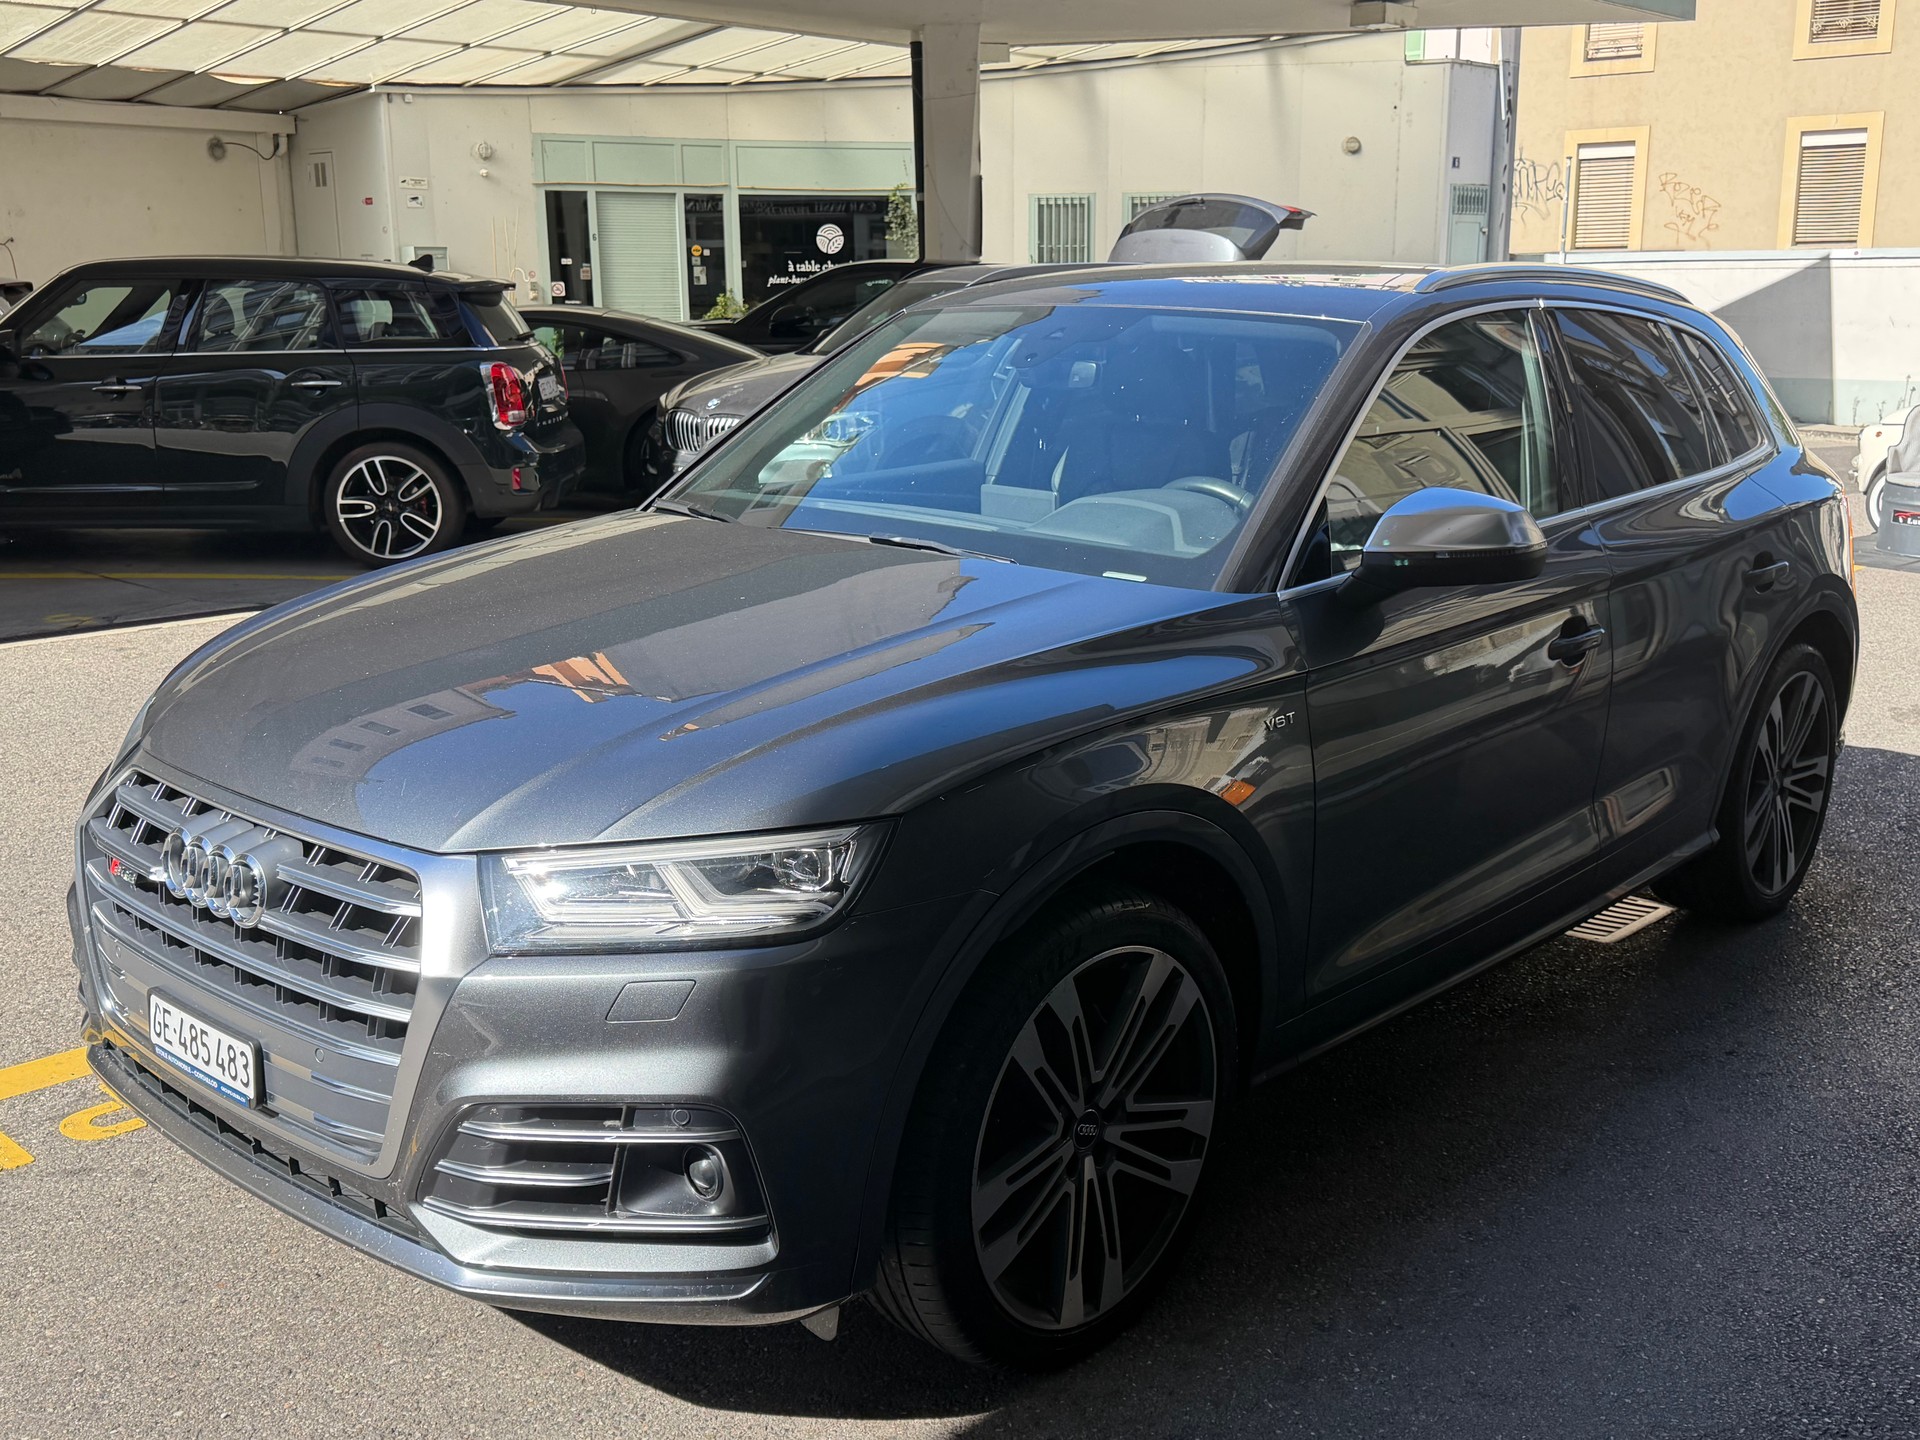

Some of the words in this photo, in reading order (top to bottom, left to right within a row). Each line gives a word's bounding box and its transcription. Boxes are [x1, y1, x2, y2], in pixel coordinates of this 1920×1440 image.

[592, 233, 597, 241] 6
[787, 260, 795, 272] à
[796, 259, 821, 272] table
